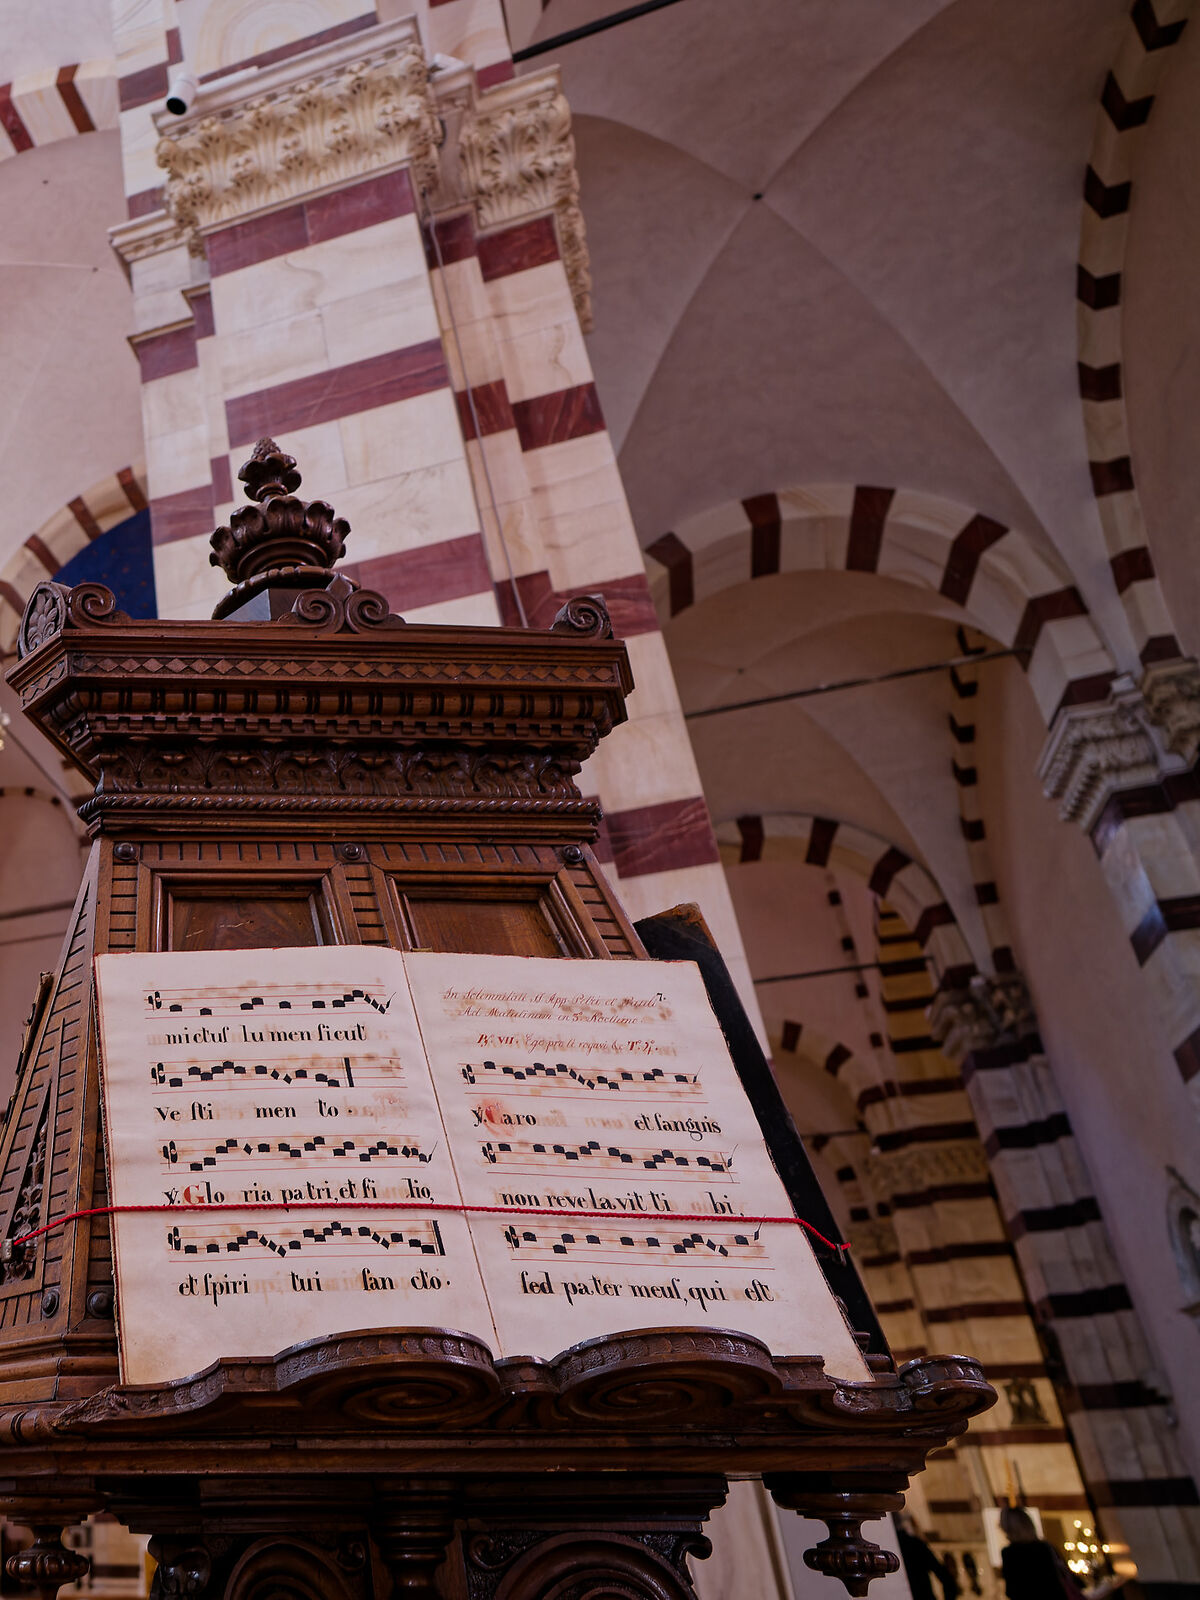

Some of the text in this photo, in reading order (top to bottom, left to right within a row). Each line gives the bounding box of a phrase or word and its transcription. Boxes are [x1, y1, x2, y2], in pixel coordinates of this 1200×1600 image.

[256, 1107, 296, 1118] men
[184, 1181, 225, 1205] Glo
[242, 1183, 274, 1202] ria
[502, 1194, 540, 1206] non
[179, 1274, 199, 1296] et
[291, 1271, 323, 1292] tui
[689, 1280, 728, 1313] qui
